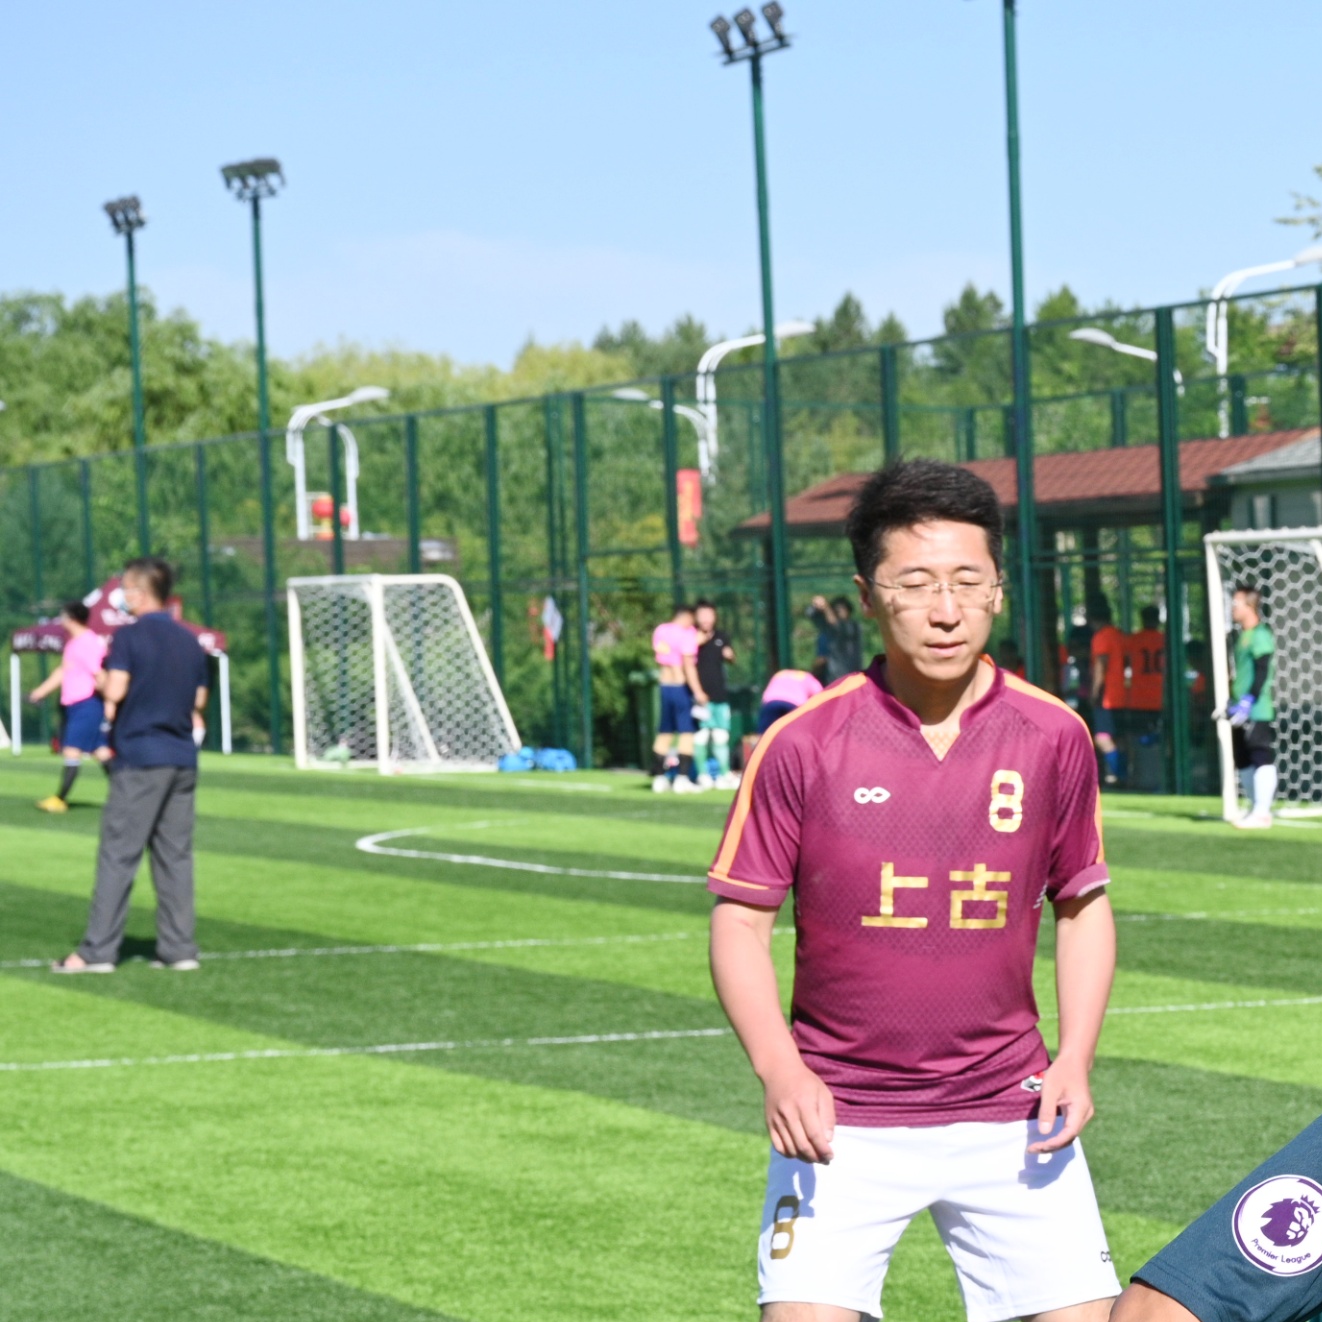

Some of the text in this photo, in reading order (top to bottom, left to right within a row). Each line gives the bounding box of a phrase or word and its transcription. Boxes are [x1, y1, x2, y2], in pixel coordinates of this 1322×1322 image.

[988, 769, 1025, 833] 8
[860, 861, 1012, 930] 上古
[769, 1194, 801, 1261] 8
[1250, 1237, 1312, 1265] Premier League
